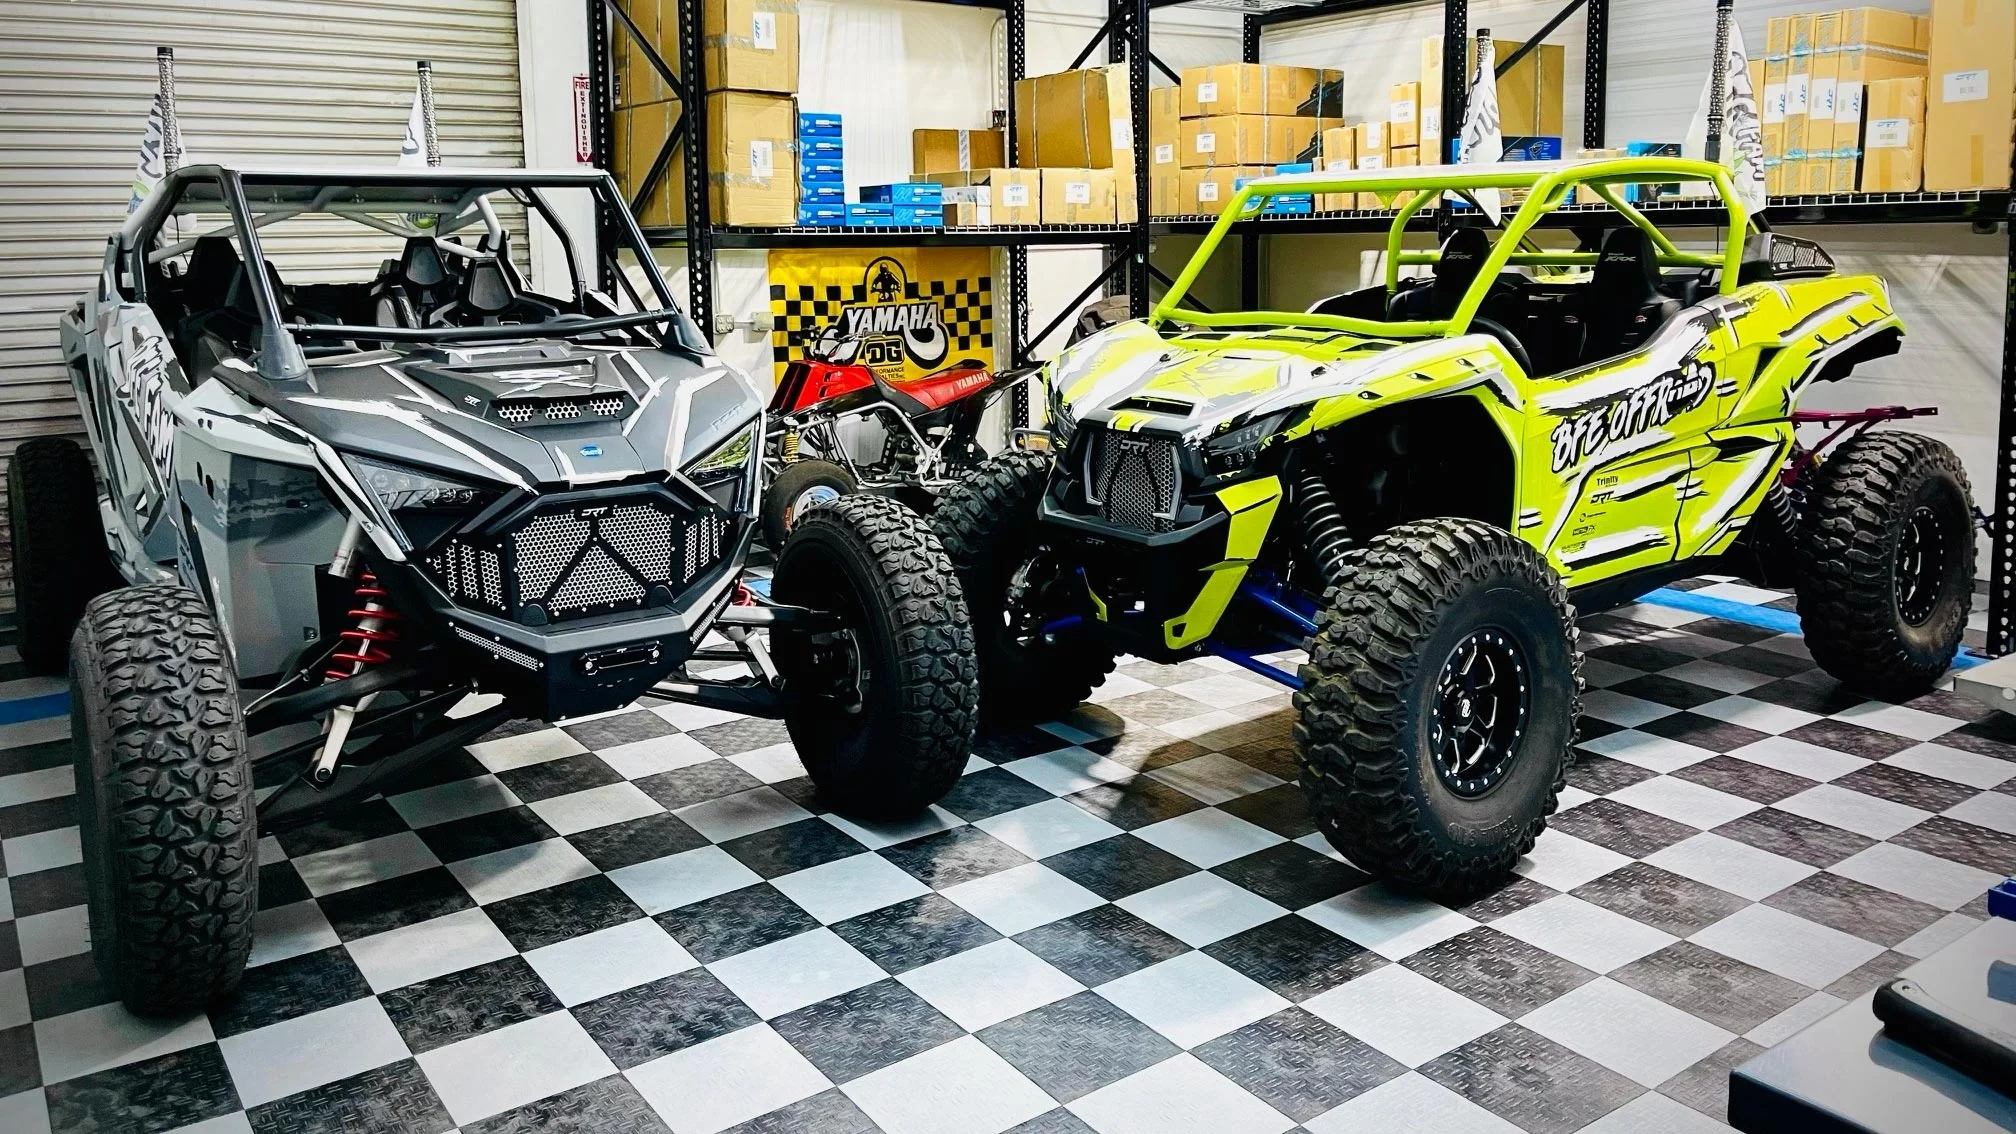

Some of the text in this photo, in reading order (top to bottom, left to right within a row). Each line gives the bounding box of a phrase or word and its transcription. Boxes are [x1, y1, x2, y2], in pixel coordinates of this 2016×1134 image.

[575, 81, 590, 90] FIRE
[579, 91, 588, 158] EXTINGUISHER
[847, 303, 937, 334] YAMAHA
[866, 341, 902, 364] DG
[956, 372, 990, 390] YAMAHA
[1120, 439, 1149, 455] DRT
[1552, 405, 1609, 473] BFE
[1596, 475, 1619, 485] Trinity
[1589, 490, 1615, 504] DRT
[581, 506, 609, 517] DRT
